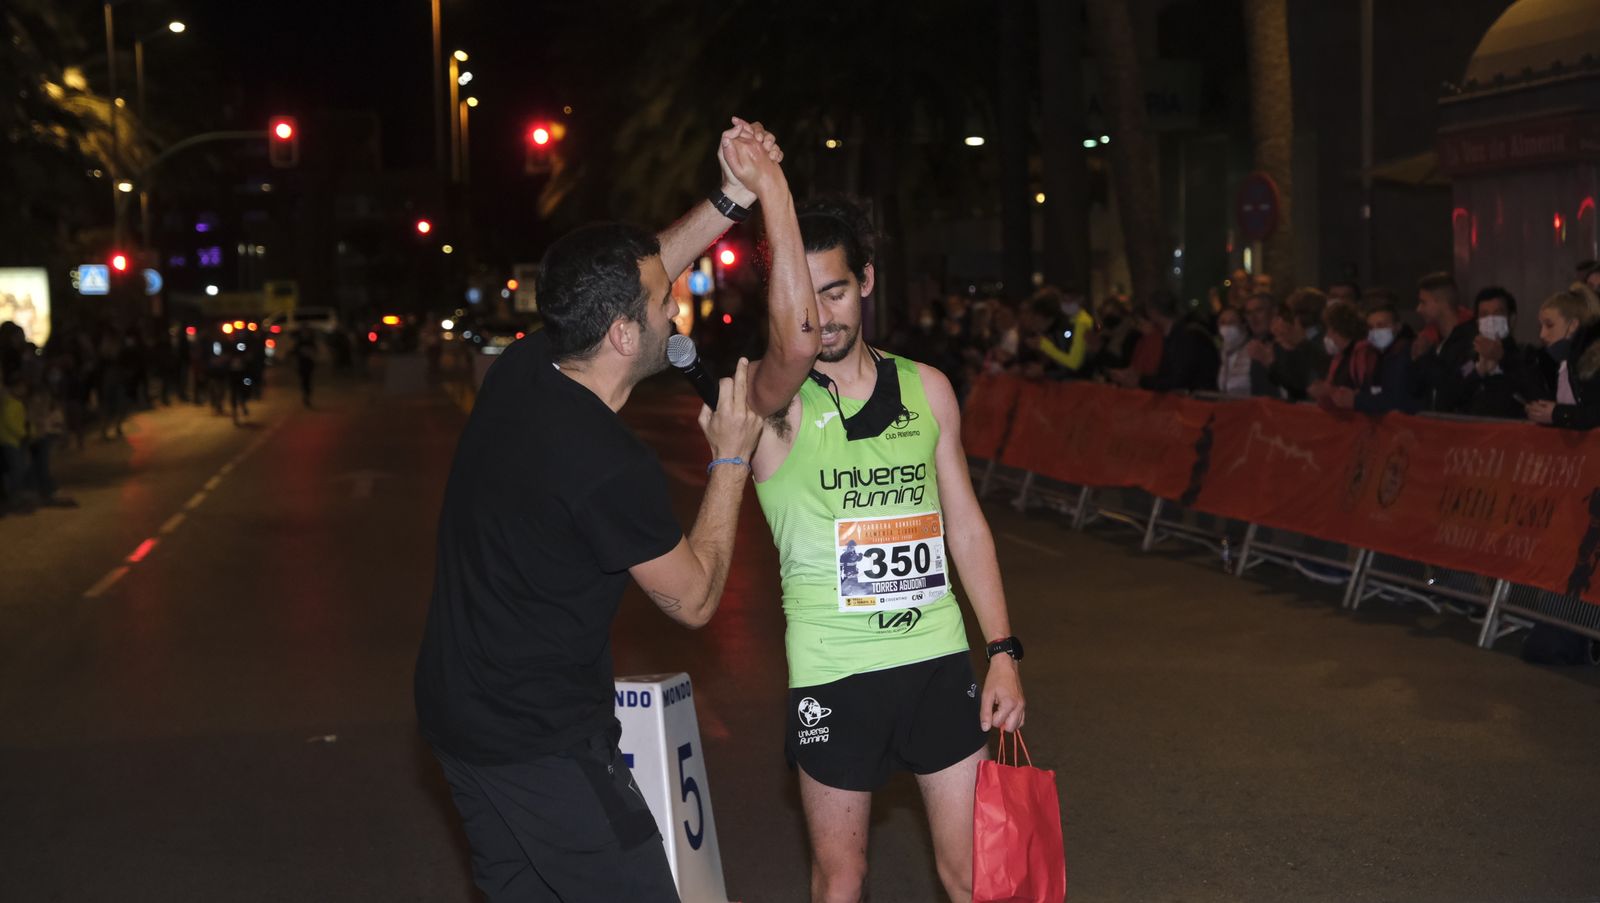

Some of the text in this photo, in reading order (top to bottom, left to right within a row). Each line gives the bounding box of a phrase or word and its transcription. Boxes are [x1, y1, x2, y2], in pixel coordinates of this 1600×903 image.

[820, 463, 927, 491] Universo
[843, 484, 926, 510] Running
[863, 543, 931, 580] 350
[872, 580, 898, 593] TORRES
[878, 610, 913, 629] VA
[615, 690, 652, 708] NDO
[662, 681, 692, 708] MONDO
[798, 726, 829, 738] Universo
[799, 734, 829, 746] Running
[677, 742, 704, 850] 5
